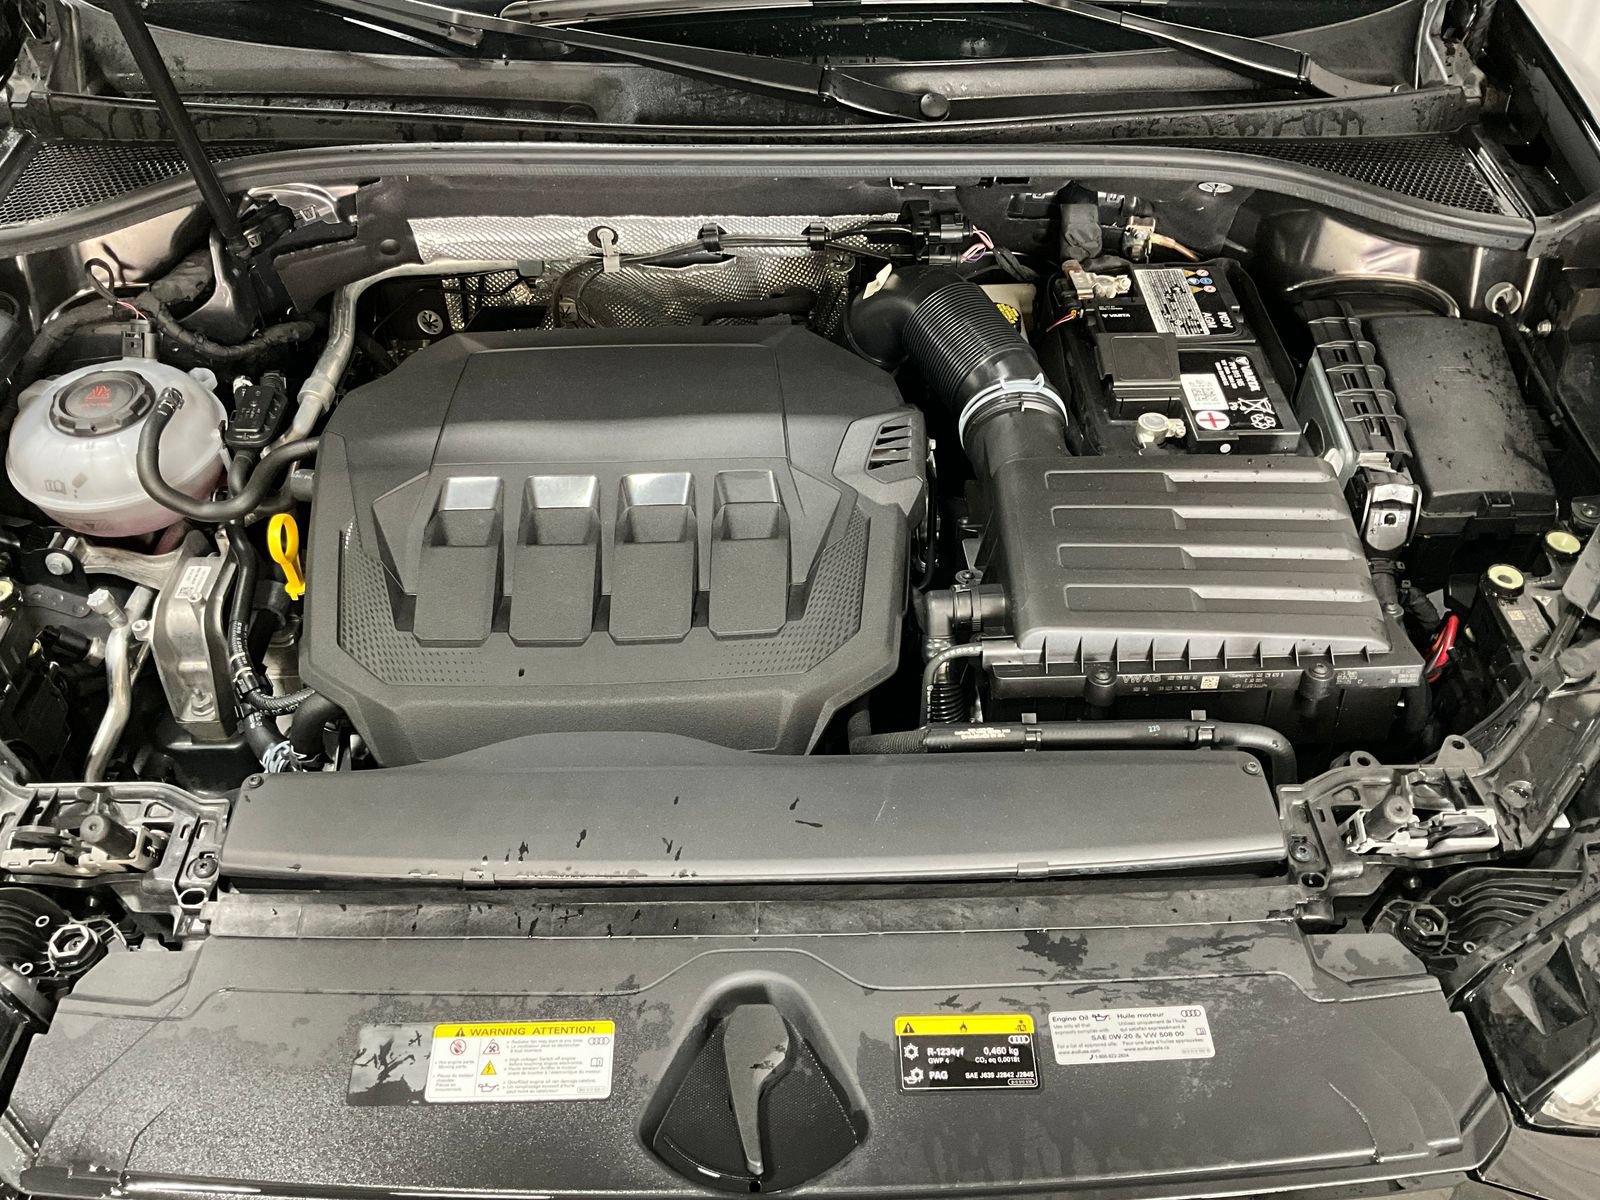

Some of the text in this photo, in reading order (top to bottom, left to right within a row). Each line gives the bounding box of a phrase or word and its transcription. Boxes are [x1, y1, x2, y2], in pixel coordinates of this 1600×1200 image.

[1202, 312, 1218, 329] AGM
[1217, 311, 1234, 329] AGM
[1142, 674, 1162, 683] AG
[470, 1025, 596, 1036] WARNING ATTENTION
[926, 1047, 964, 1057] R-1234yf
[1008, 1045, 1019, 1056] kg
[928, 1071, 949, 1080] PAG
